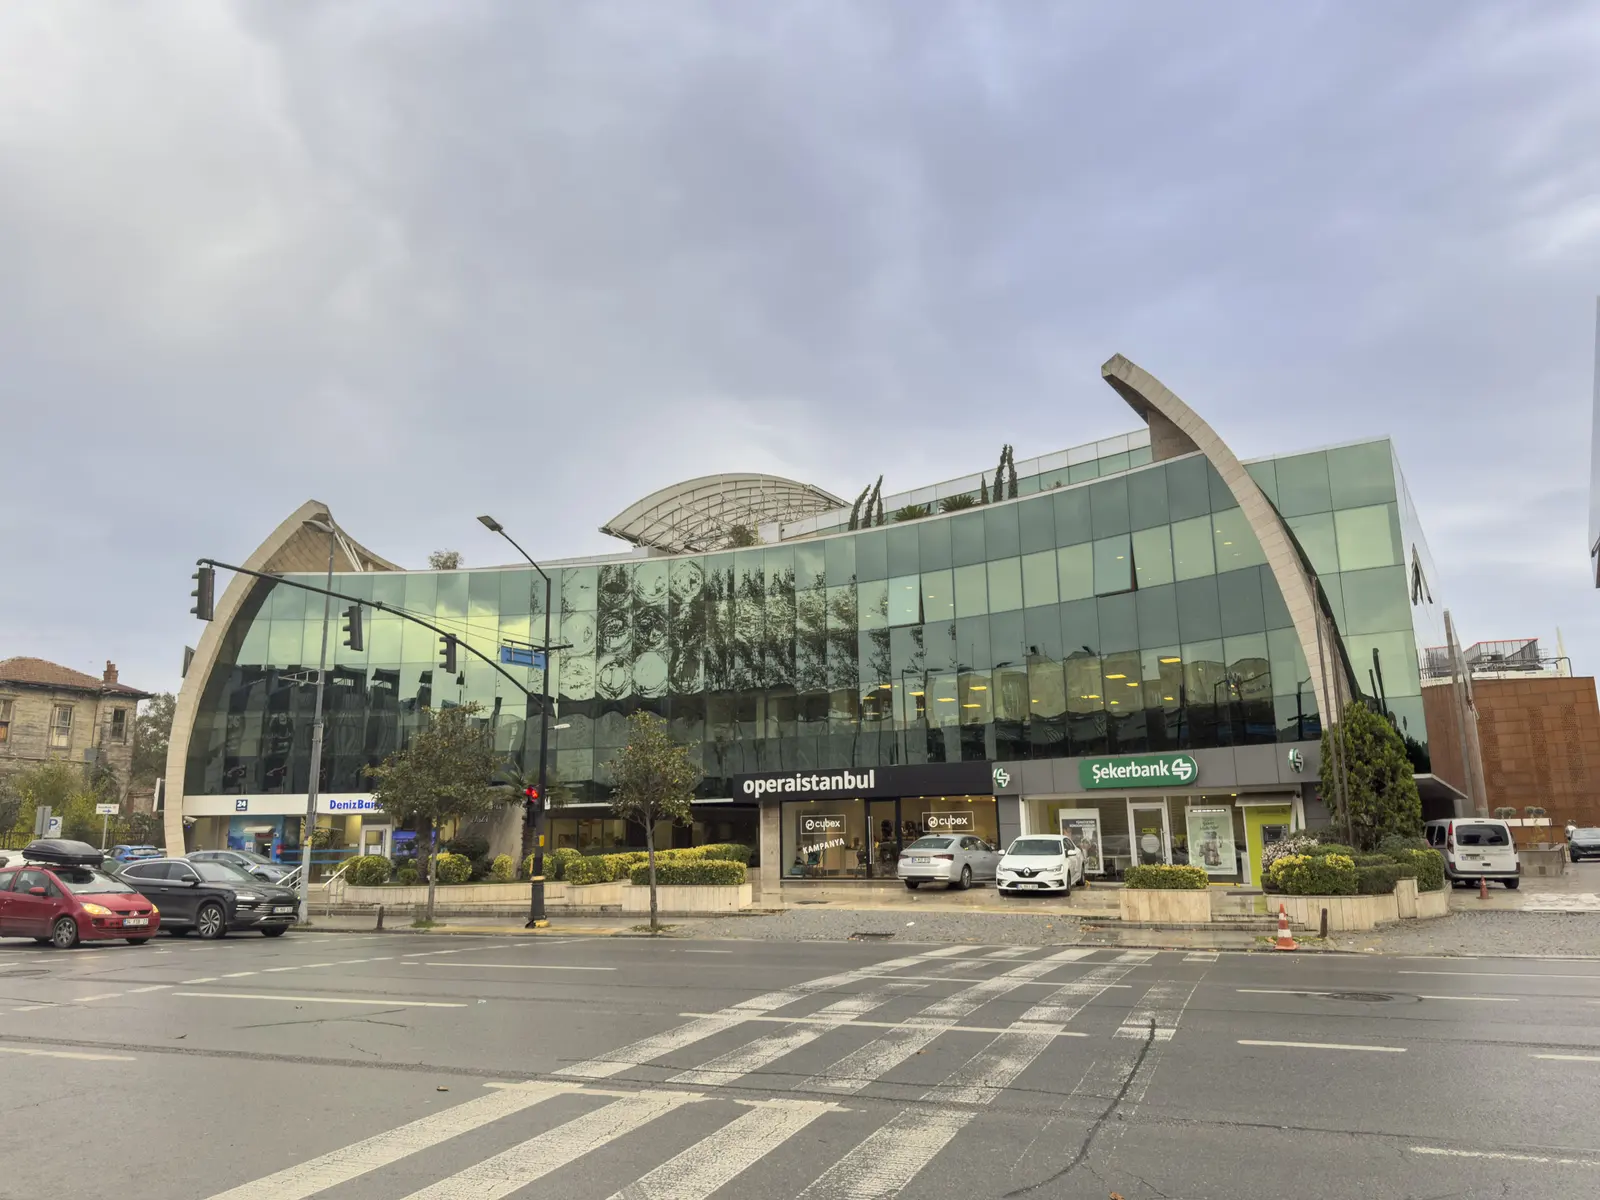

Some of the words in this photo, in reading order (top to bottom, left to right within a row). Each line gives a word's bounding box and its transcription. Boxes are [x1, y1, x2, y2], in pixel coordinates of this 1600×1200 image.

[1092, 760, 1170, 784] Şekerbank
[743, 769, 875, 798] operaistanbul
[237, 800, 247, 808] 24
[329, 799, 383, 810] DenizBan
[48, 818, 59, 830] P
[815, 818, 840, 831] cybex
[938, 815, 968, 829] cybex
[802, 838, 845, 855] KAMPANYA
